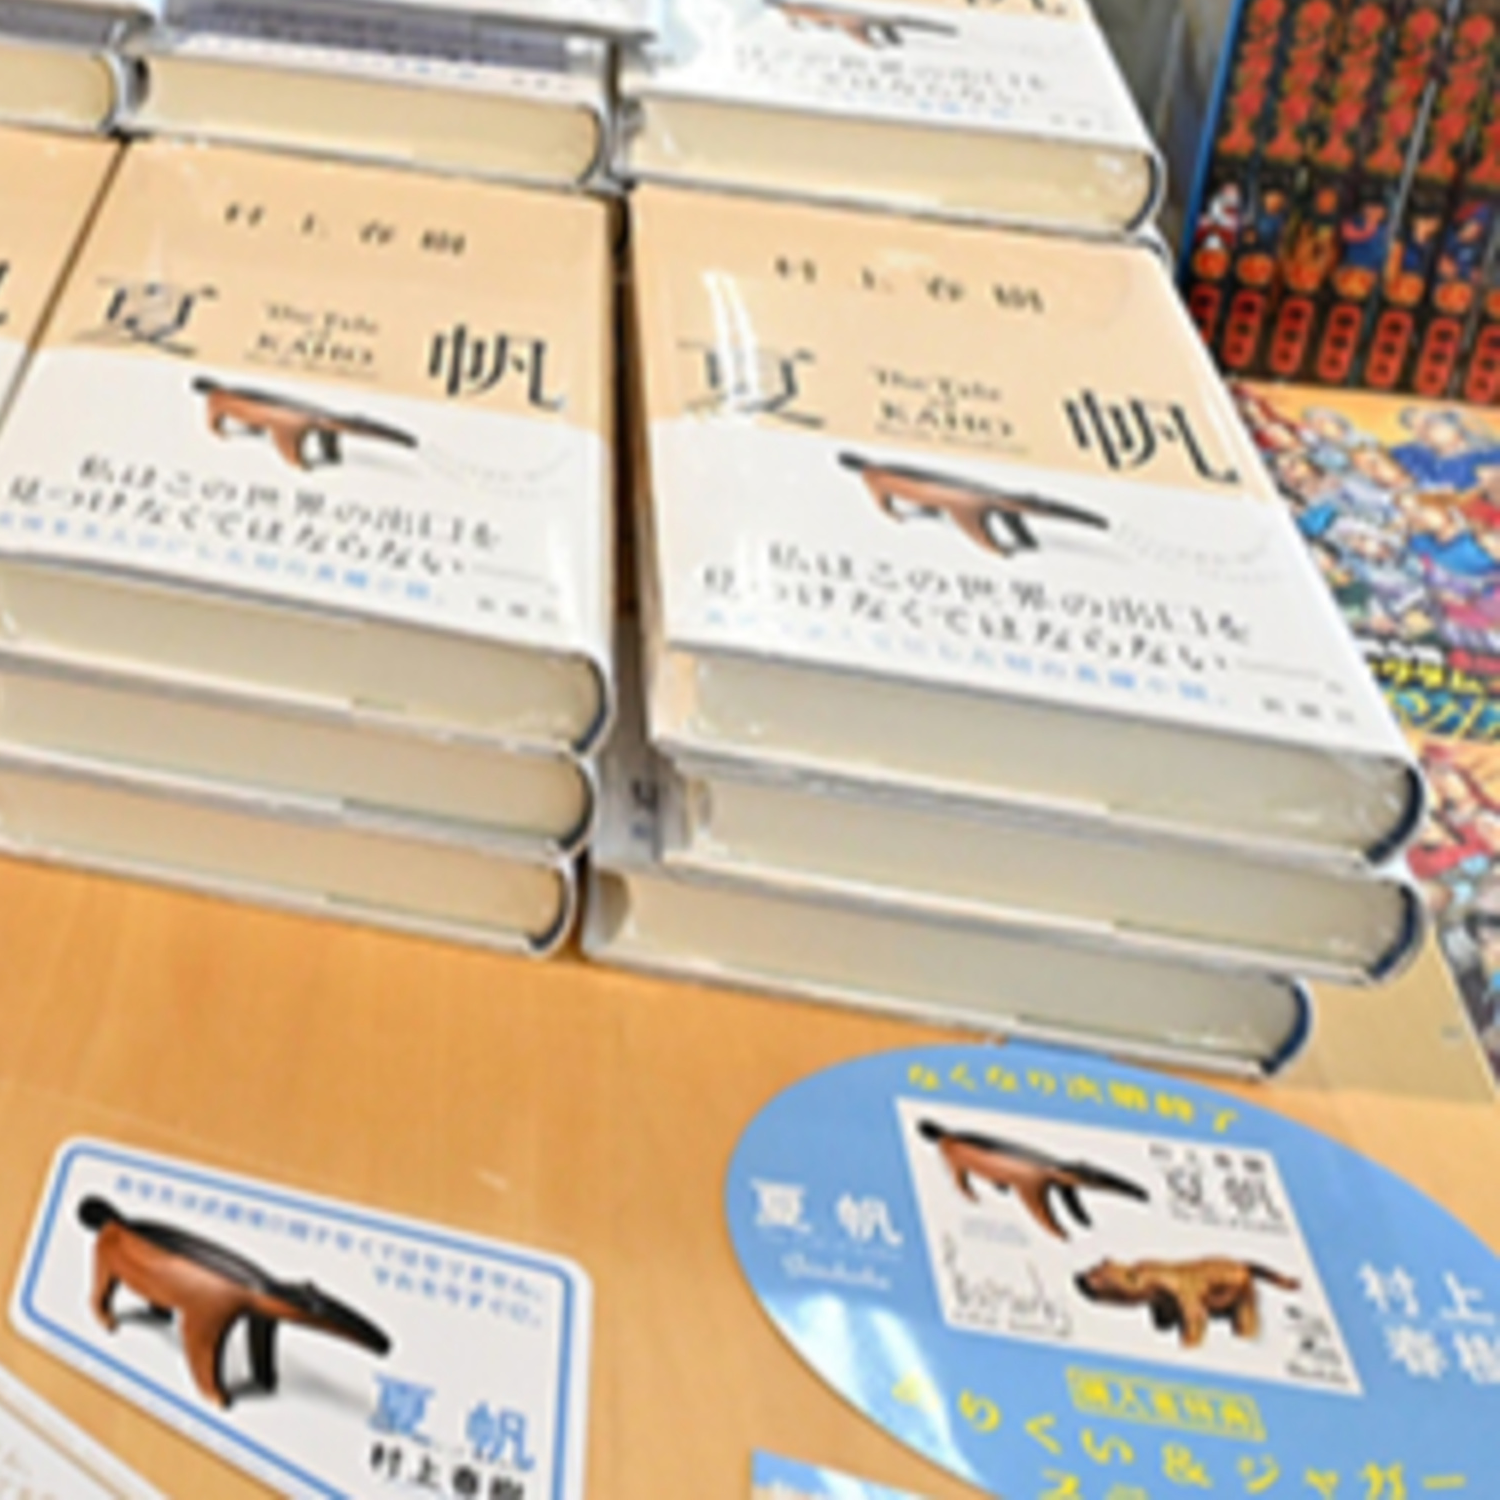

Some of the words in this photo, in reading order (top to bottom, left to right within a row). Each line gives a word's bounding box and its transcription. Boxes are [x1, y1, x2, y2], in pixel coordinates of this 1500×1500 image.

[427, 322, 566, 413] 帆
[1062, 388, 1241, 486] 帆
[1357, 1260, 1496, 1326] 村上
[366, 1371, 537, 1473] 夏帆
